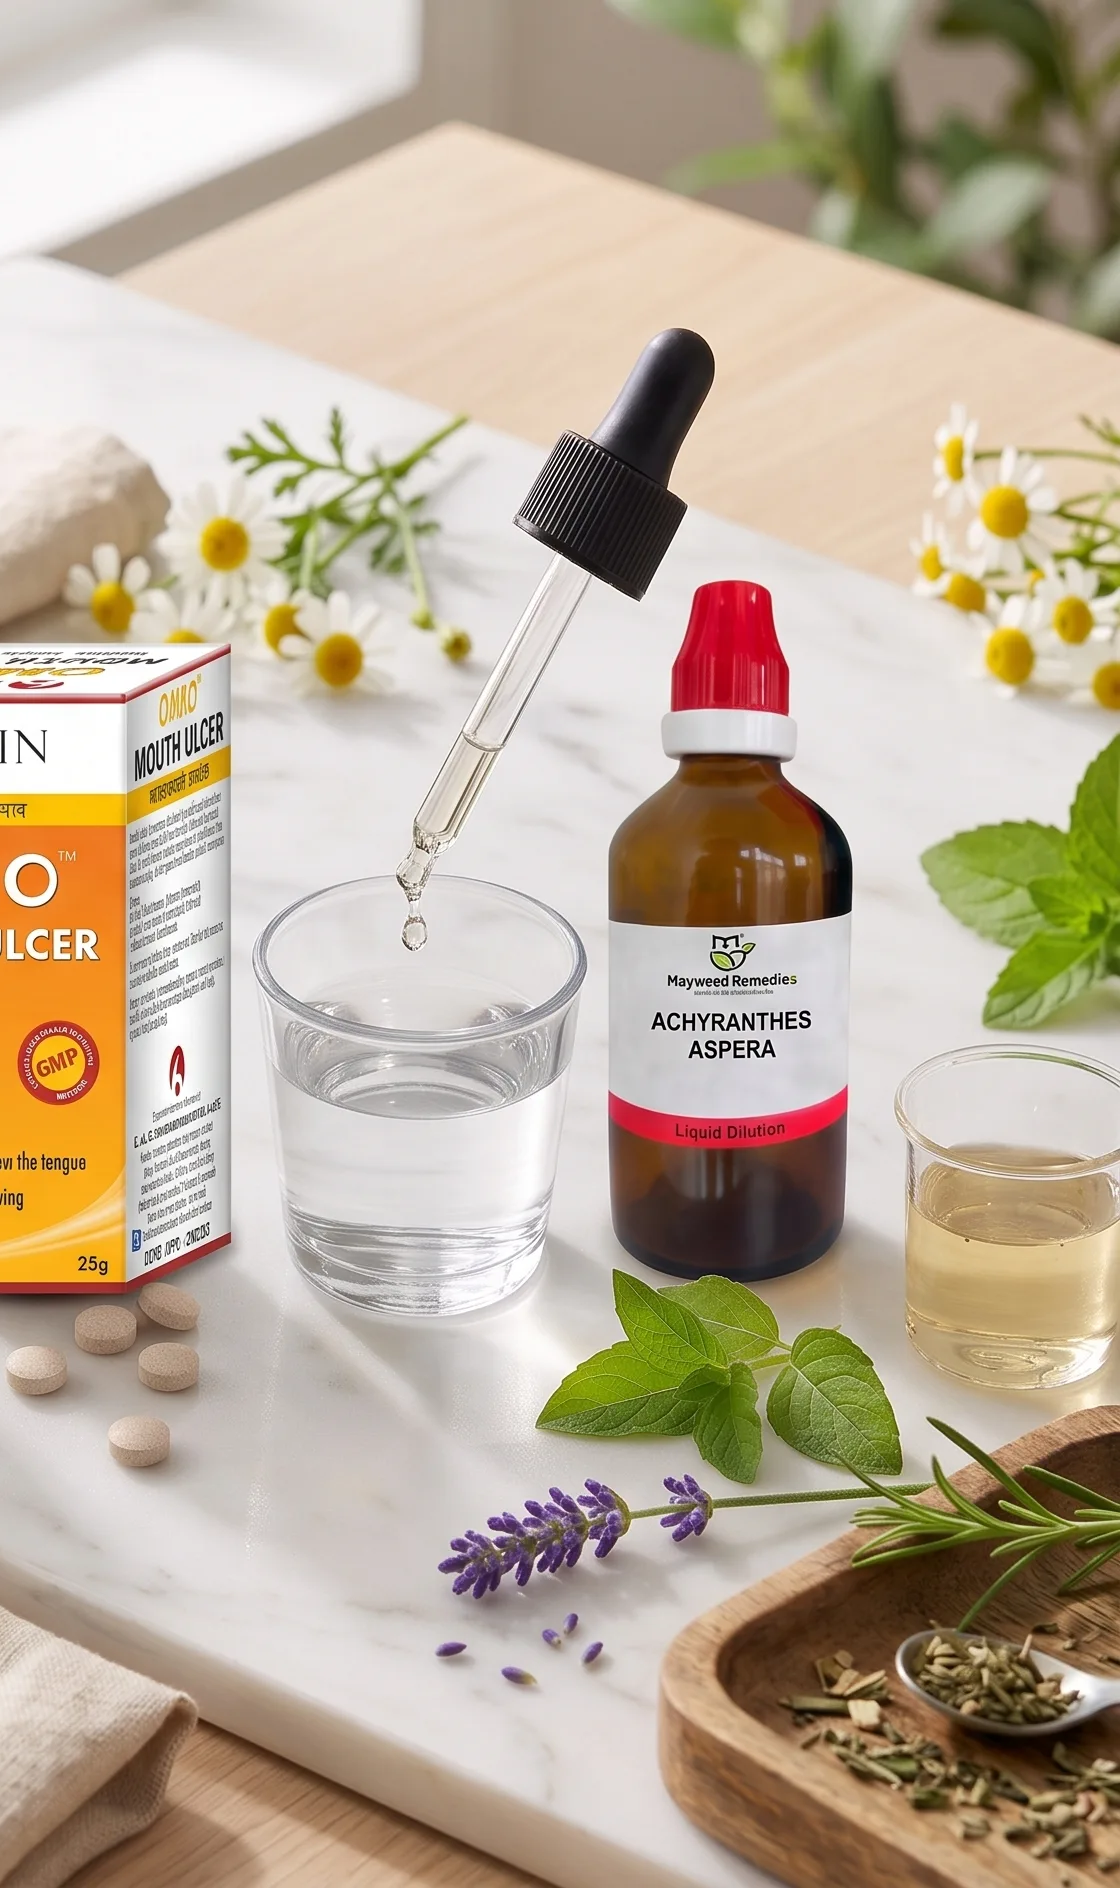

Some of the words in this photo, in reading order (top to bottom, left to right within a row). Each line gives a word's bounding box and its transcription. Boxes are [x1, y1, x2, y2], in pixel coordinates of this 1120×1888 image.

[134, 730, 181, 782] MOUTH
[185, 711, 224, 757] ULCER
[667, 974, 729, 990] Mayweed
[732, 973, 798, 987] Remedies
[650, 1010, 812, 1032] ACHYRANTHES
[688, 1039, 776, 1059] ASPERA
[36, 1047, 78, 1078] GMP
[675, 1123, 722, 1142] Liquid
[727, 1123, 786, 1140] Dilution
[16, 1150, 38, 1170] the
[77, 1256, 109, 1276] 25g
